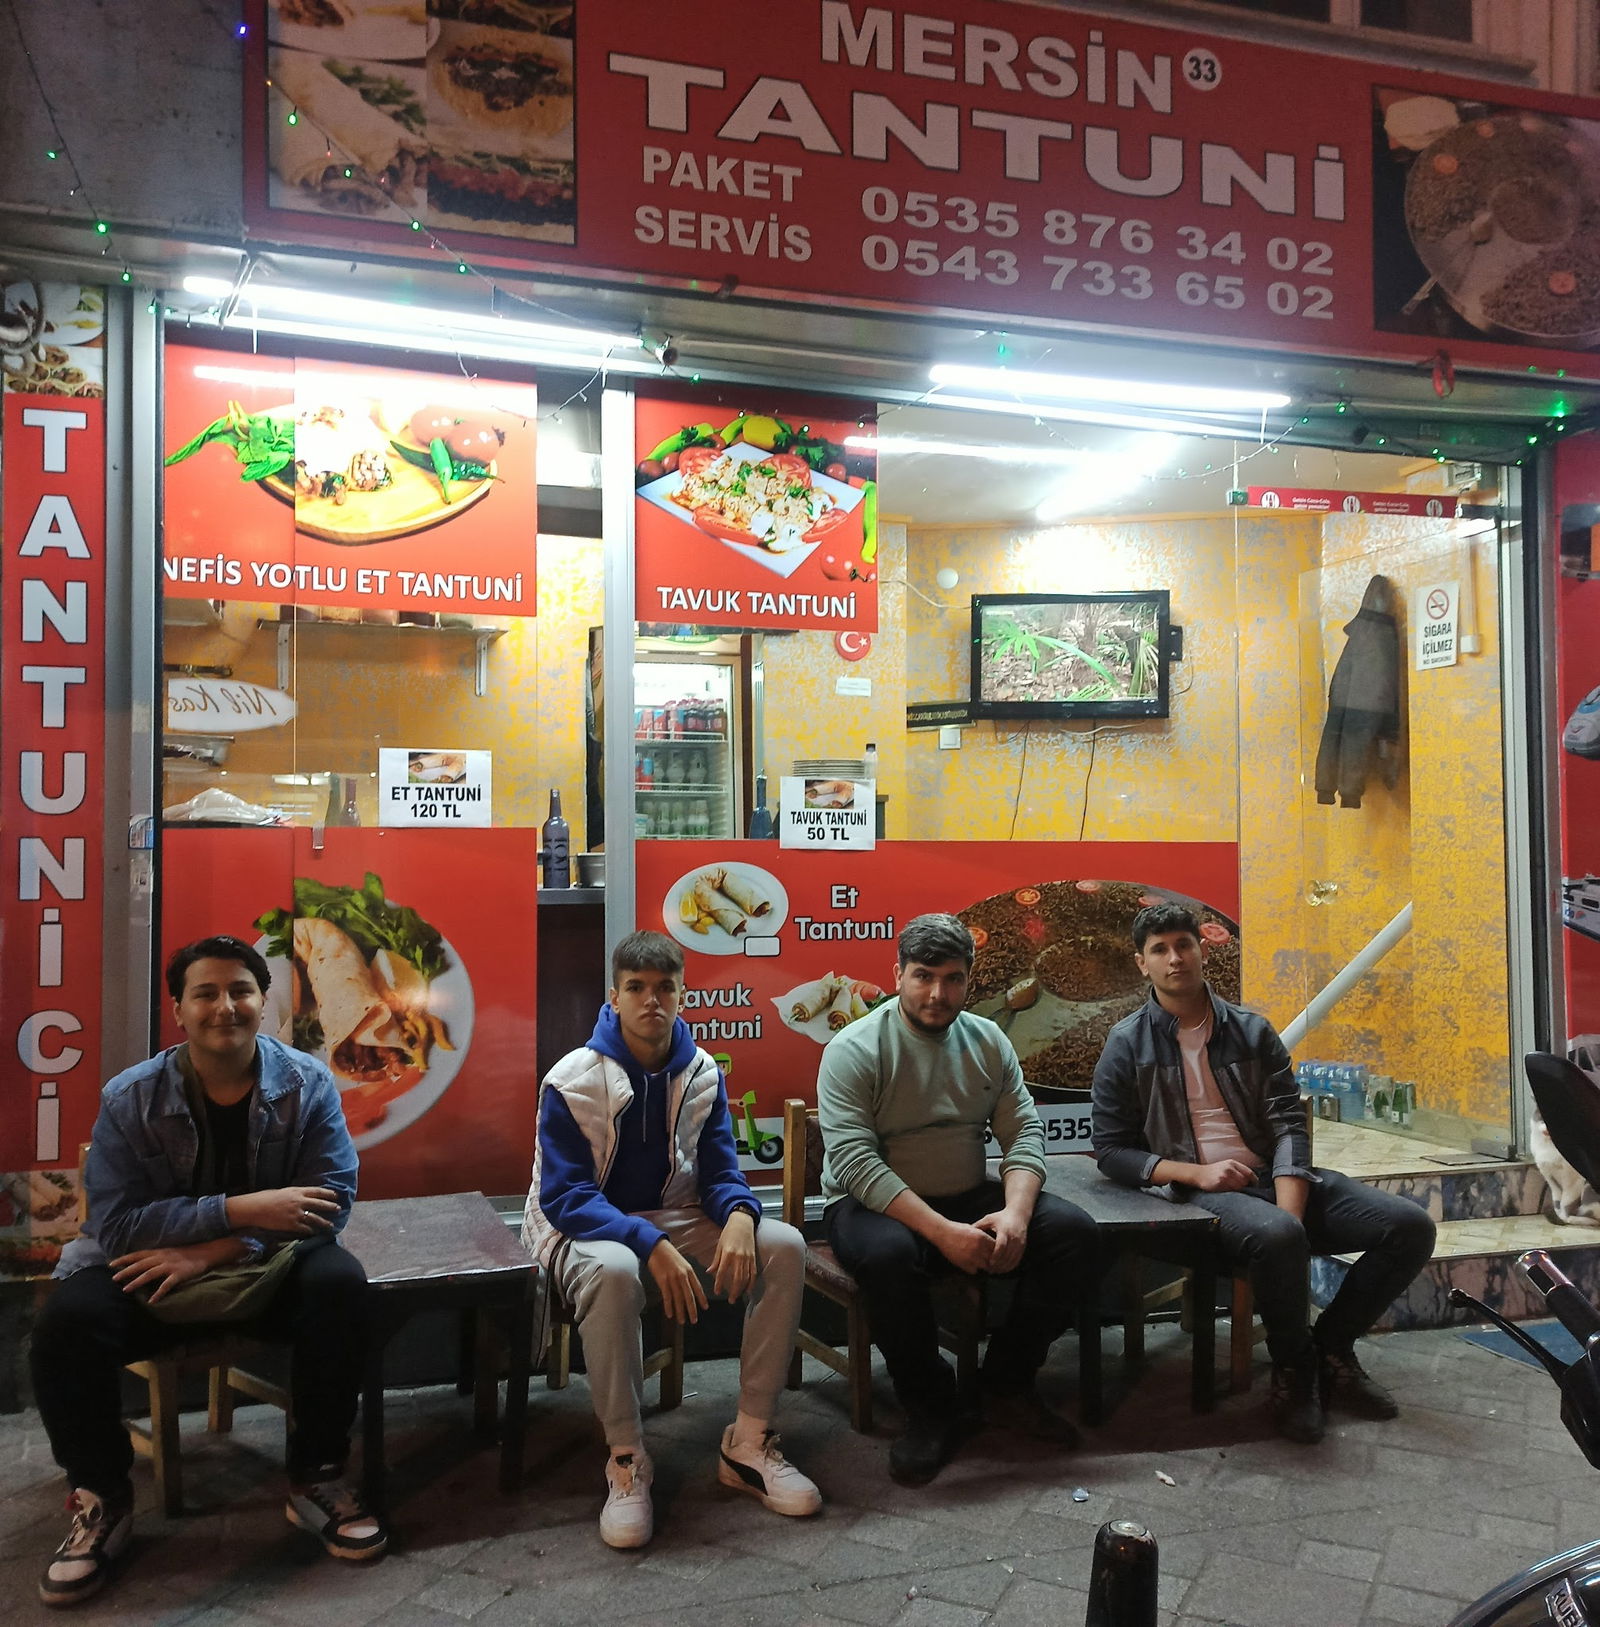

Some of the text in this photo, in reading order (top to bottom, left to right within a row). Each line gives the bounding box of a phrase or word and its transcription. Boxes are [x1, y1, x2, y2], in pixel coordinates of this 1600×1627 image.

[820, 0, 1217, 114] MERSİN 33
[609, 52, 1345, 222] TANTUNİ
[643, 146, 803, 202] PAKET
[634, 205, 812, 262] SERVİS
[861, 186, 1334, 276] 0535 876 34 02
[861, 235, 1334, 320] 0543 733 65 02
[163, 553, 523, 602] NEFİS YOTLU ET TANTUNİ
[656, 586, 857, 619] TAVUK TANTUNİ
[1424, 622, 1452, 638] SİGARA
[17, 408, 92, 1162] TANTUNİCİ
[391, 784, 481, 801] ET TANTUNİ
[411, 804, 461, 818] 120 TL
[790, 809, 867, 826] TAVUK TANTUNİ
[807, 827, 850, 841] 50 TL
[831, 885, 859, 909] Et
[794, 916, 895, 941] Tantuni
[683, 983, 753, 1009] avuk
[687, 1014, 762, 1041] ntuni
[1041, 1117, 1093, 1141] 535
